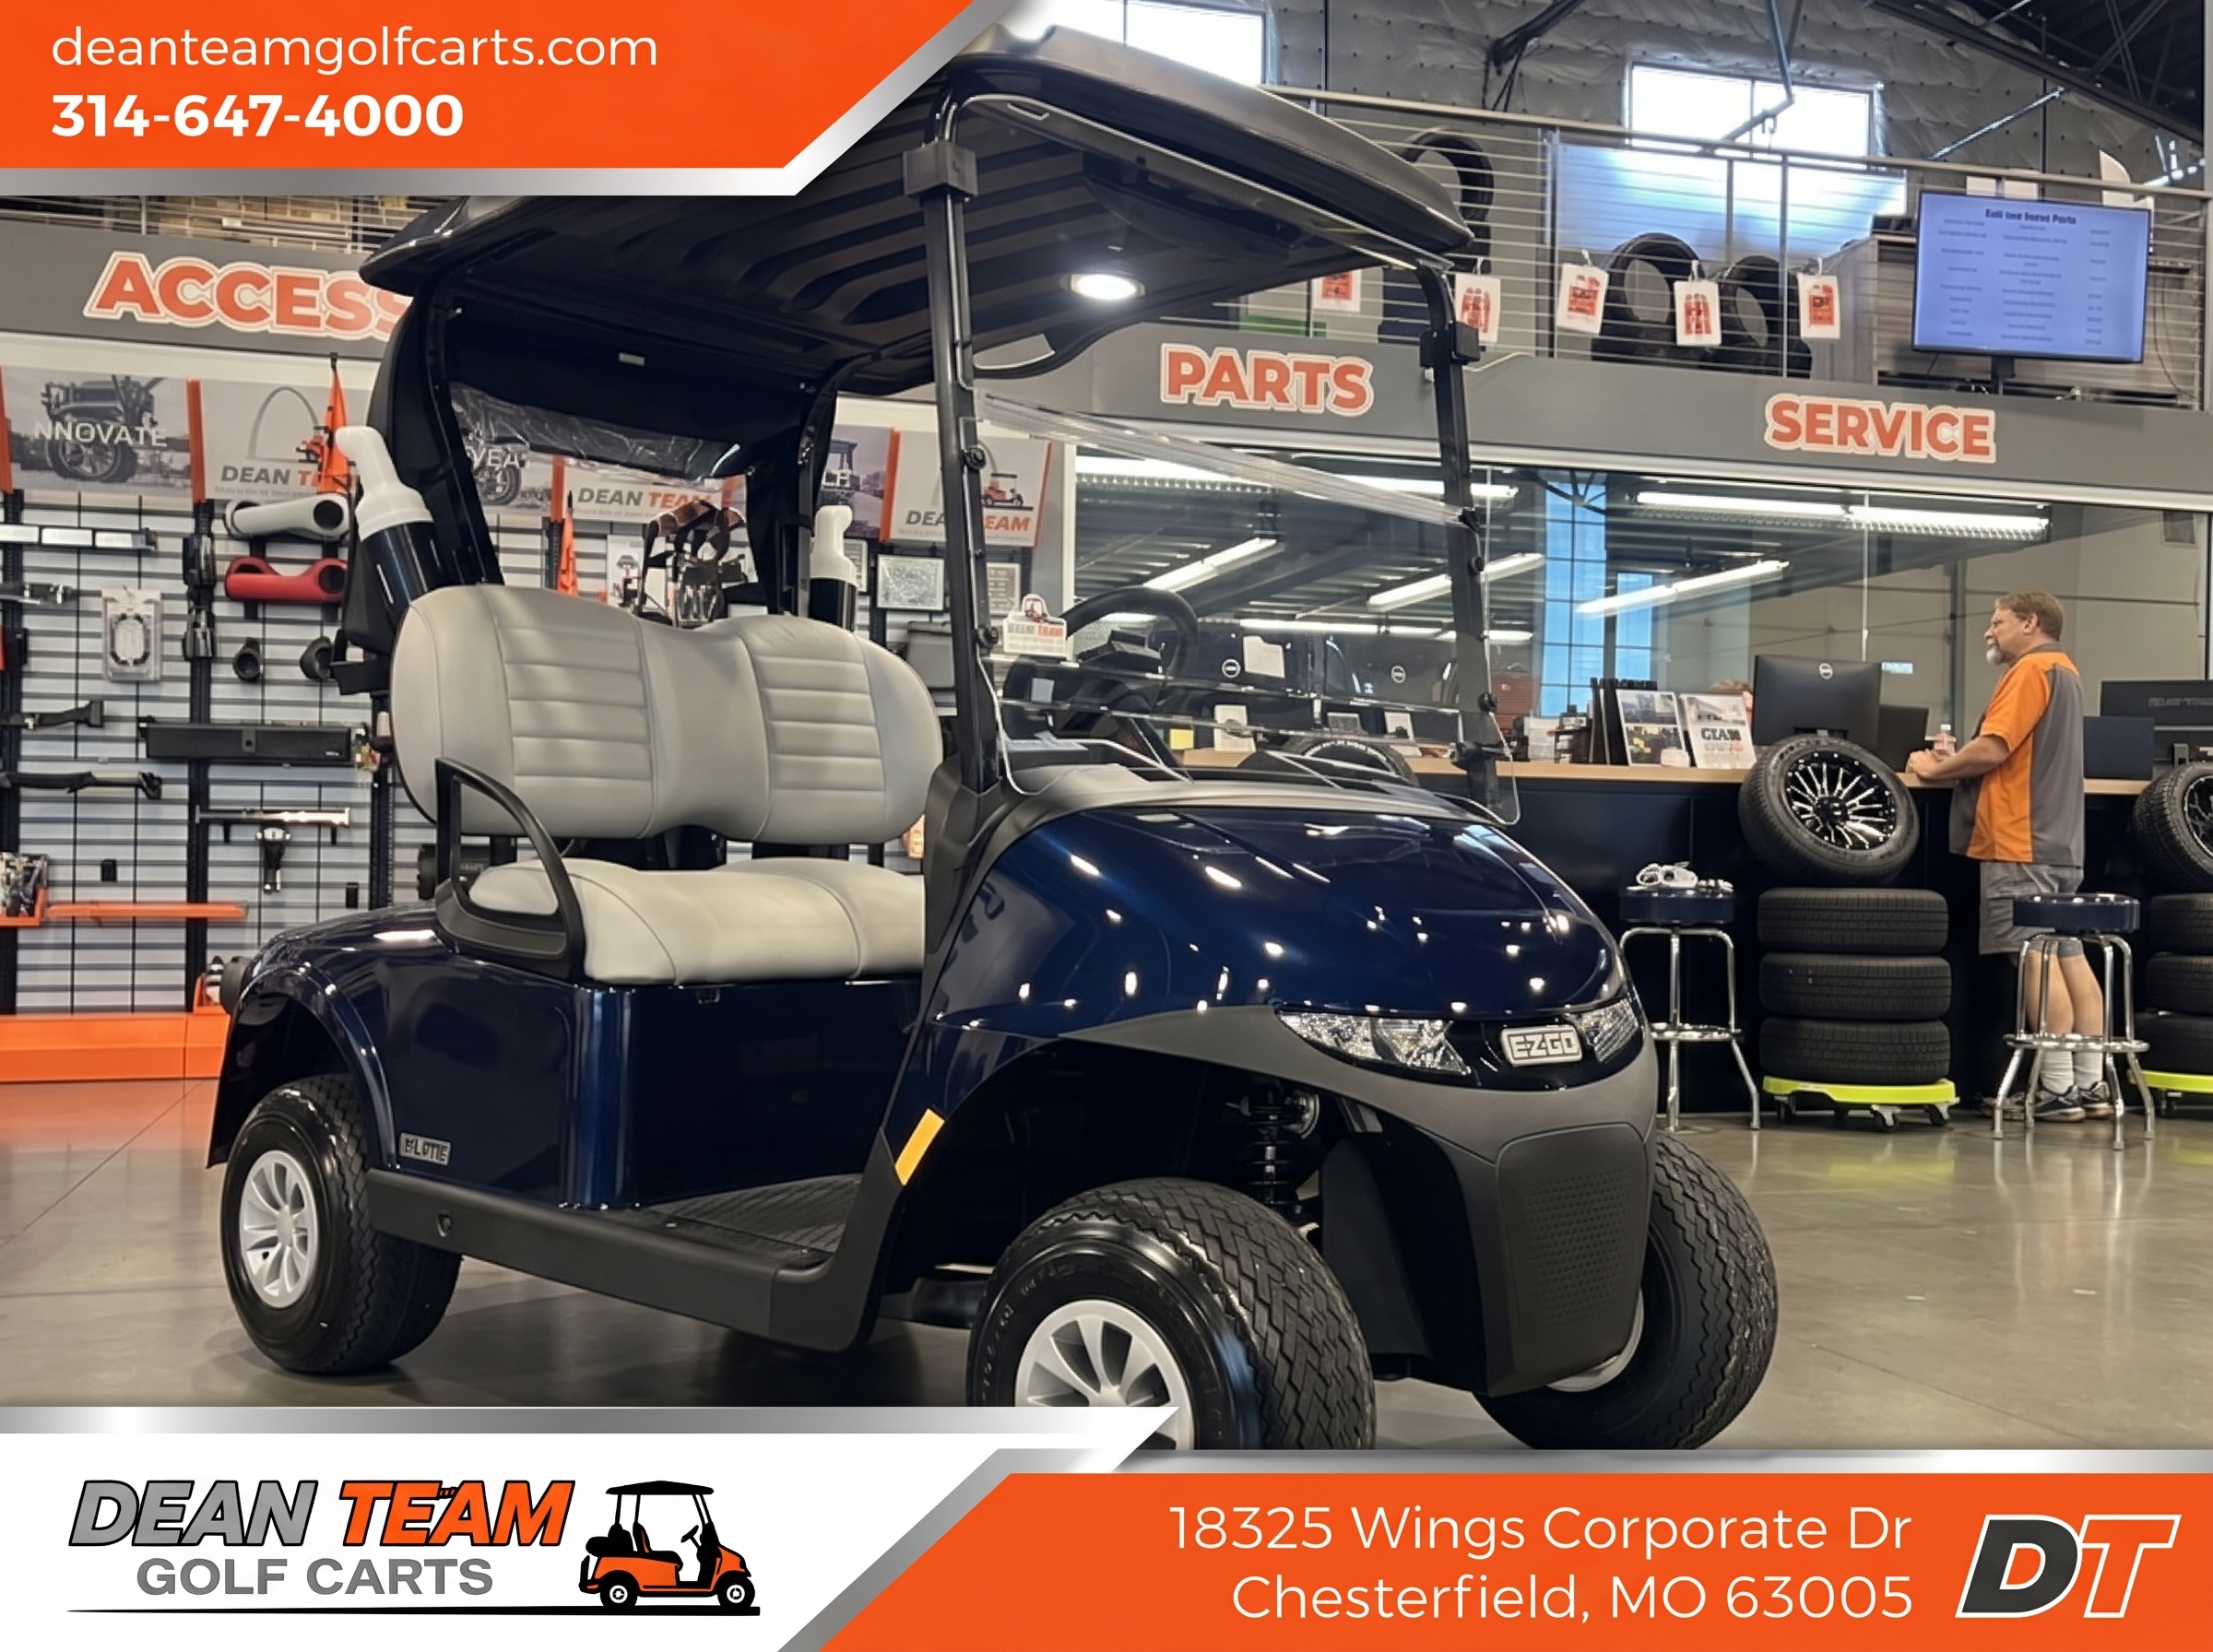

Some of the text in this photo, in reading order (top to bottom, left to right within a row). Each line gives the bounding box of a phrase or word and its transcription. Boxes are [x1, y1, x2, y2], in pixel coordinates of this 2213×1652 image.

[1161, 343, 1374, 417] PARTS
[1764, 393, 1996, 464] SERVICE
[220, 466, 290, 485] DEAN
[577, 488, 644, 506] DEAN
[984, 515, 1031, 531] EAM
